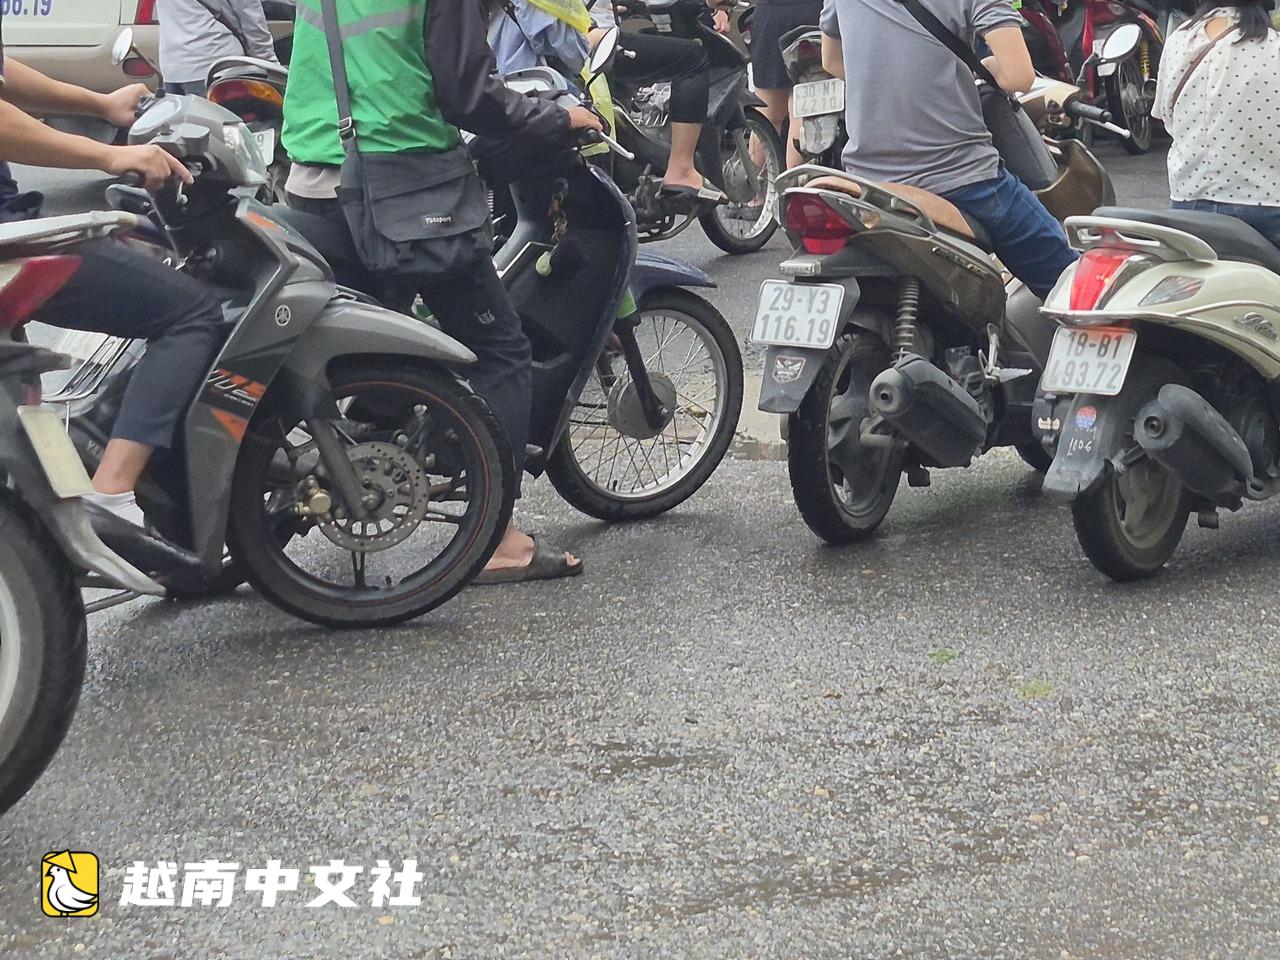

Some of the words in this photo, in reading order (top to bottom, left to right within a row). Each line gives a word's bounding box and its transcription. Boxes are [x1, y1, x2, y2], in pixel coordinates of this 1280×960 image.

[769, 286, 831, 314] 29-Y3
[760, 313, 831, 343] 116.19
[1065, 331, 1123, 359] 18-B1
